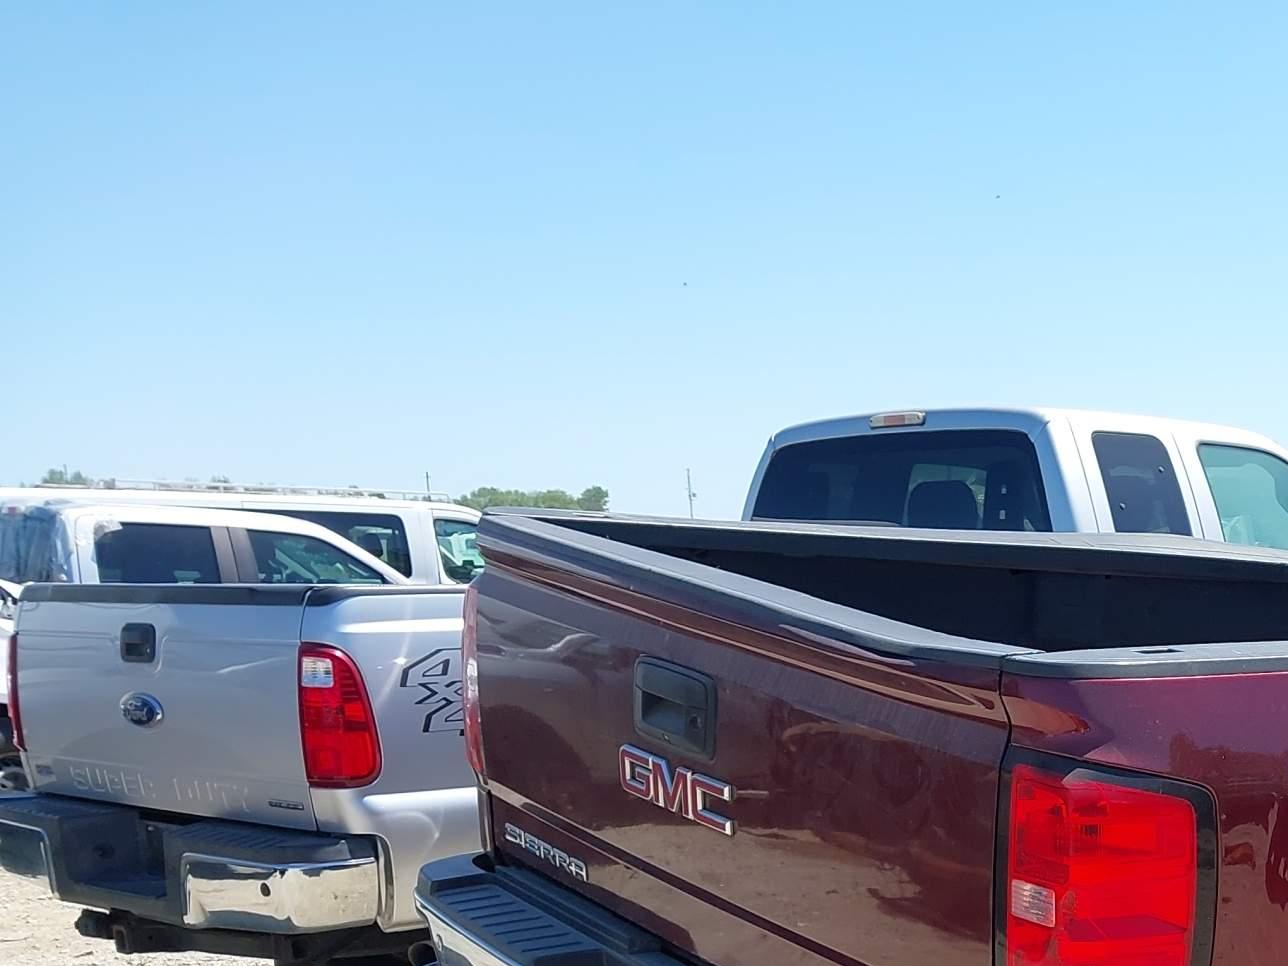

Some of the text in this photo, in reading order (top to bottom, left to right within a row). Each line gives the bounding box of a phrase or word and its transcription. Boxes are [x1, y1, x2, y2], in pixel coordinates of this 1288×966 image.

[69, 765, 156, 800] SUPER
[618, 743, 734, 836] GMC
[504, 822, 589, 882] SIERRA
